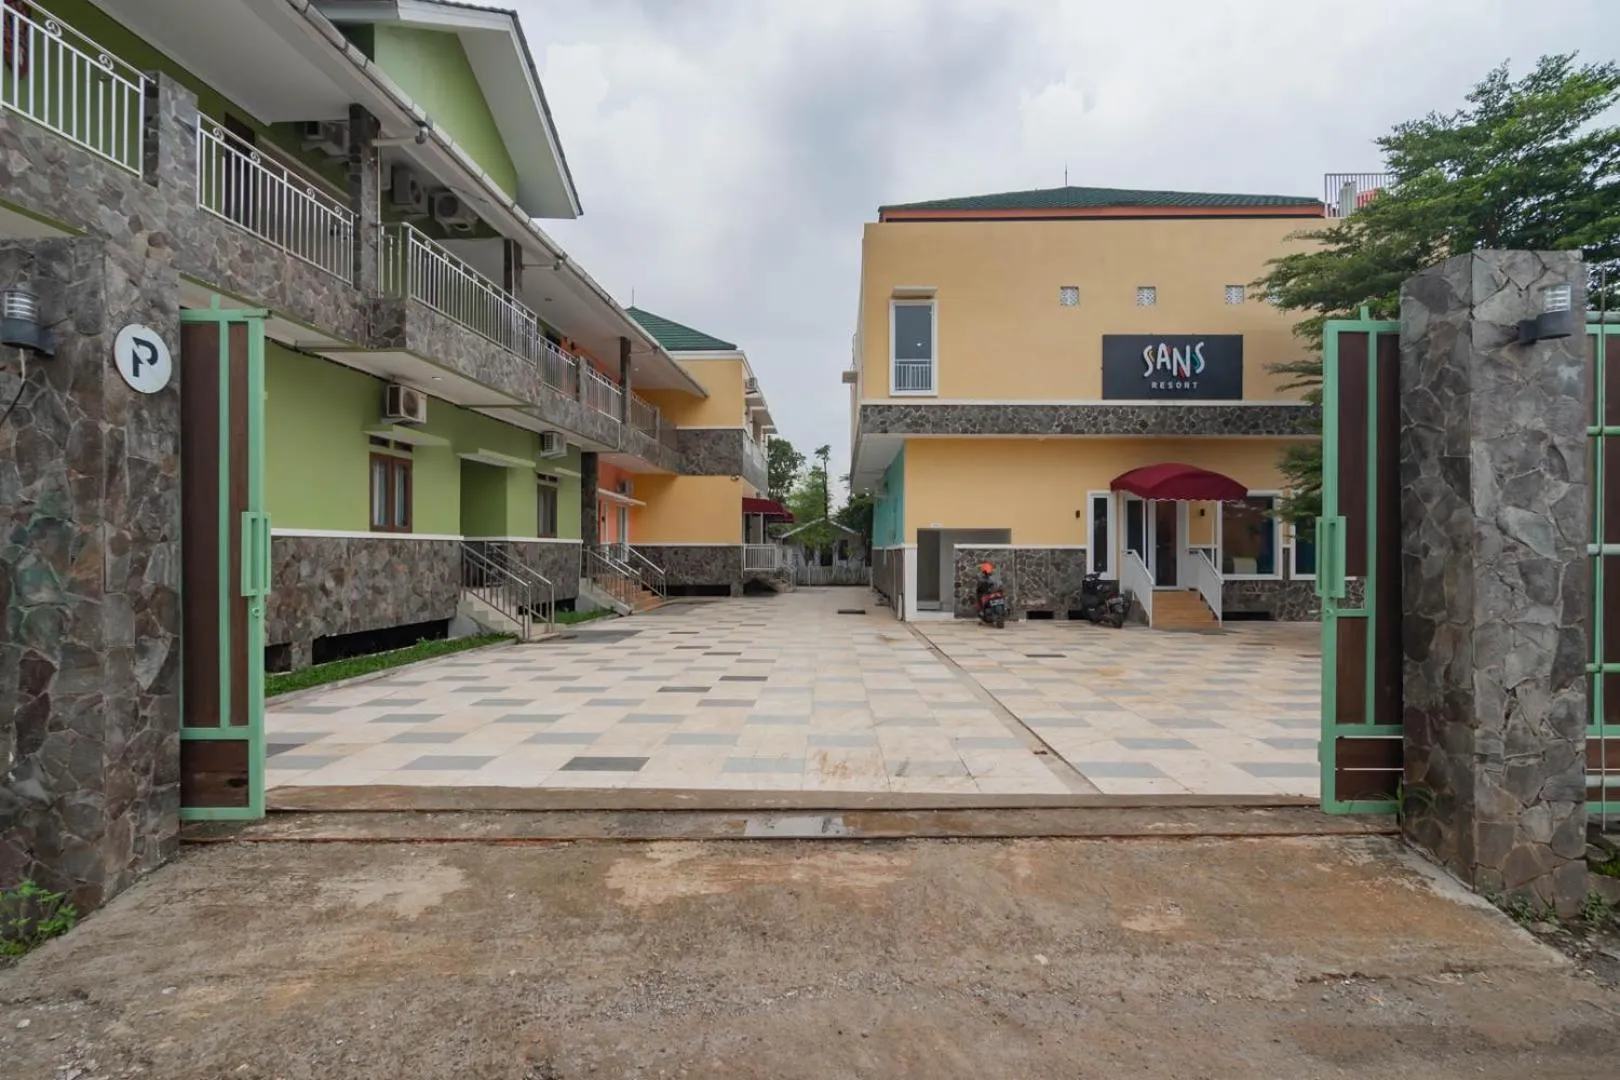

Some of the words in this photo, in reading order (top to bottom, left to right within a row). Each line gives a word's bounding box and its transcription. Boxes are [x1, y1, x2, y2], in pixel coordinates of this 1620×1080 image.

[132, 336, 159, 378] P
[1142, 341, 1206, 378] SANS
[1151, 381, 1199, 390] RESORT
